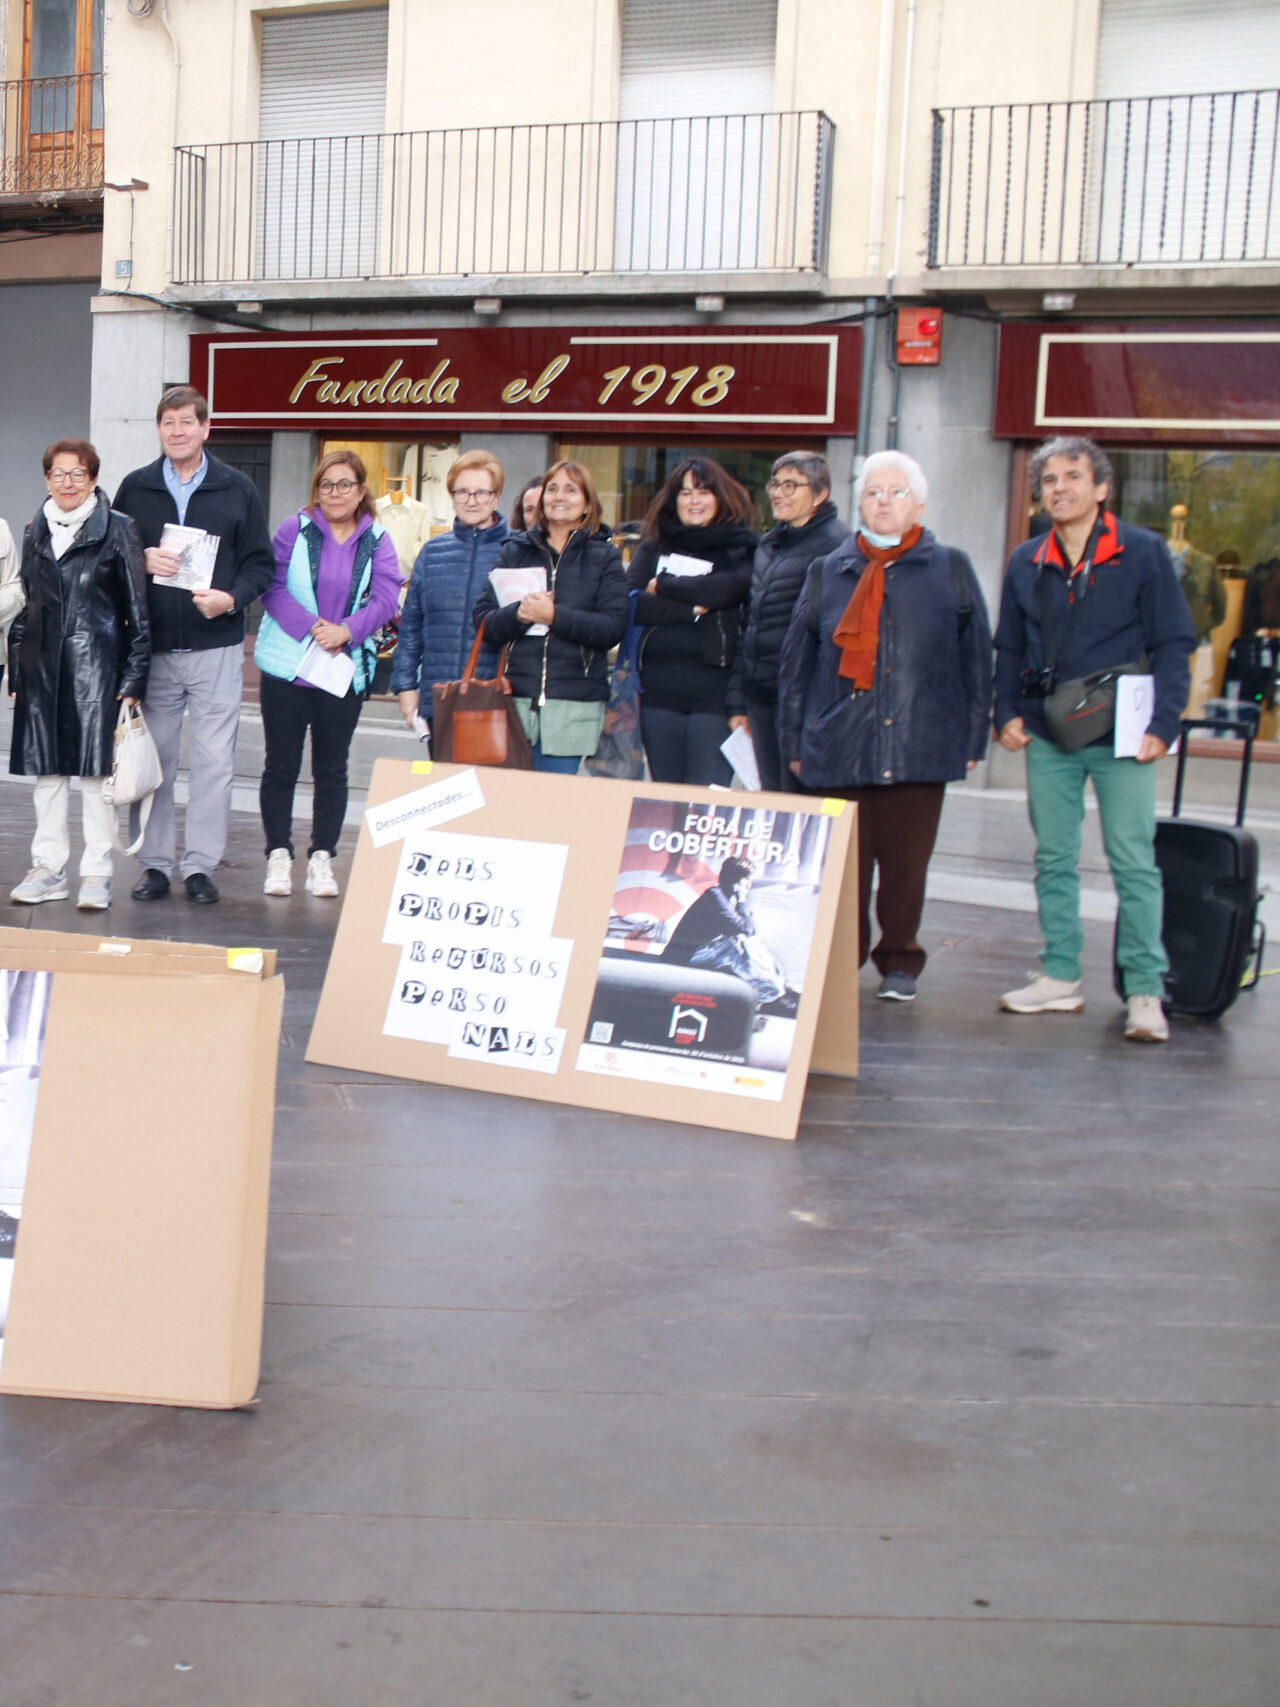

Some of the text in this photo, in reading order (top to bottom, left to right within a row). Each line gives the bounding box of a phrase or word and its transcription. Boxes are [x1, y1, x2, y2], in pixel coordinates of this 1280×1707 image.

[120, 261, 128, 275] 5
[289, 353, 736, 407] Fundada el 1918
[683, 813, 773, 841] FORA DE
[648, 830, 801, 866] COBERTURA
[398, 893, 525, 929] PROPIS
[462, 1022, 558, 1056] NALS
